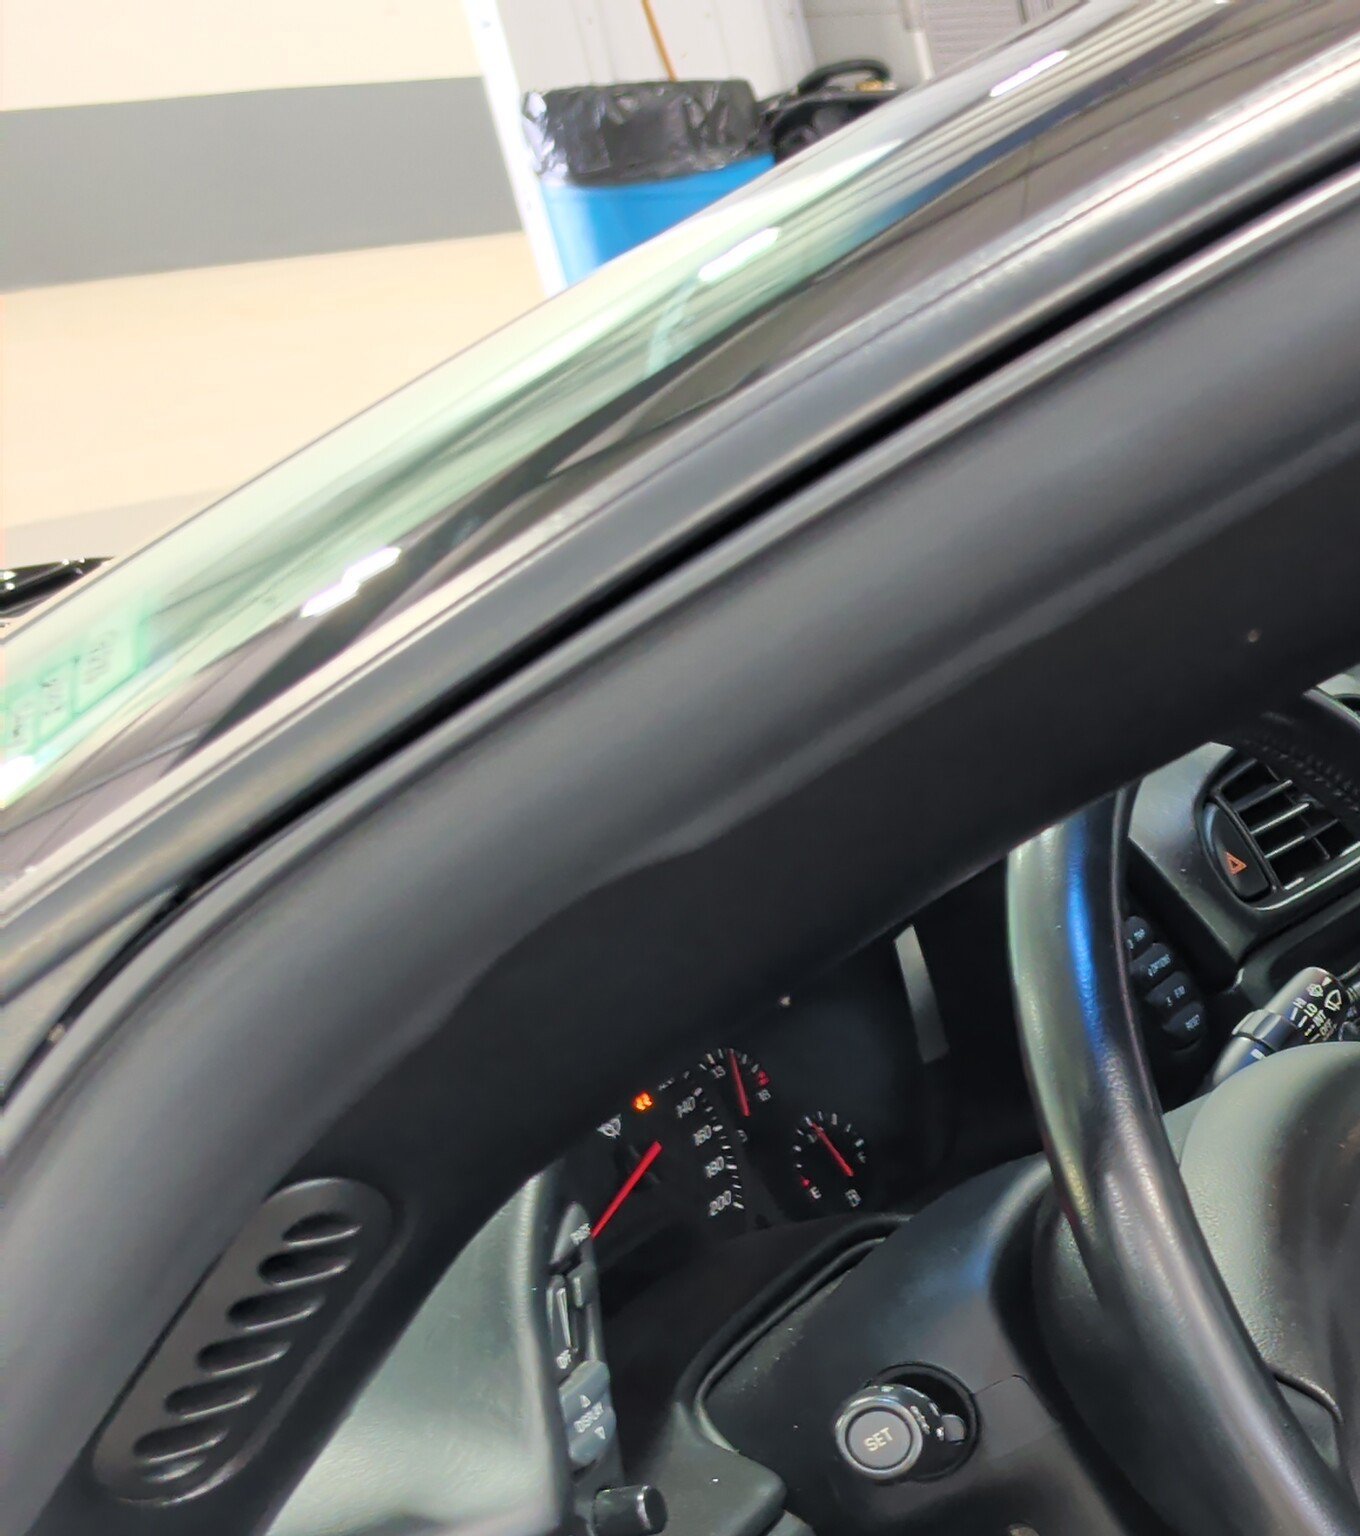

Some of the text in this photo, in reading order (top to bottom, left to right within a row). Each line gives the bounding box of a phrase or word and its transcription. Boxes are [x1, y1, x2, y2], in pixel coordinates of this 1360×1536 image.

[1292, 997, 1307, 1009] HI
[1303, 1002, 1319, 1018] LO
[1312, 1009, 1327, 1028] INT
[675, 1095, 697, 1119] 140
[692, 1124, 713, 1147] 160
[704, 1155, 725, 1179] 180
[707, 1189, 732, 1217] 200
[863, 1426, 894, 1452] SET
